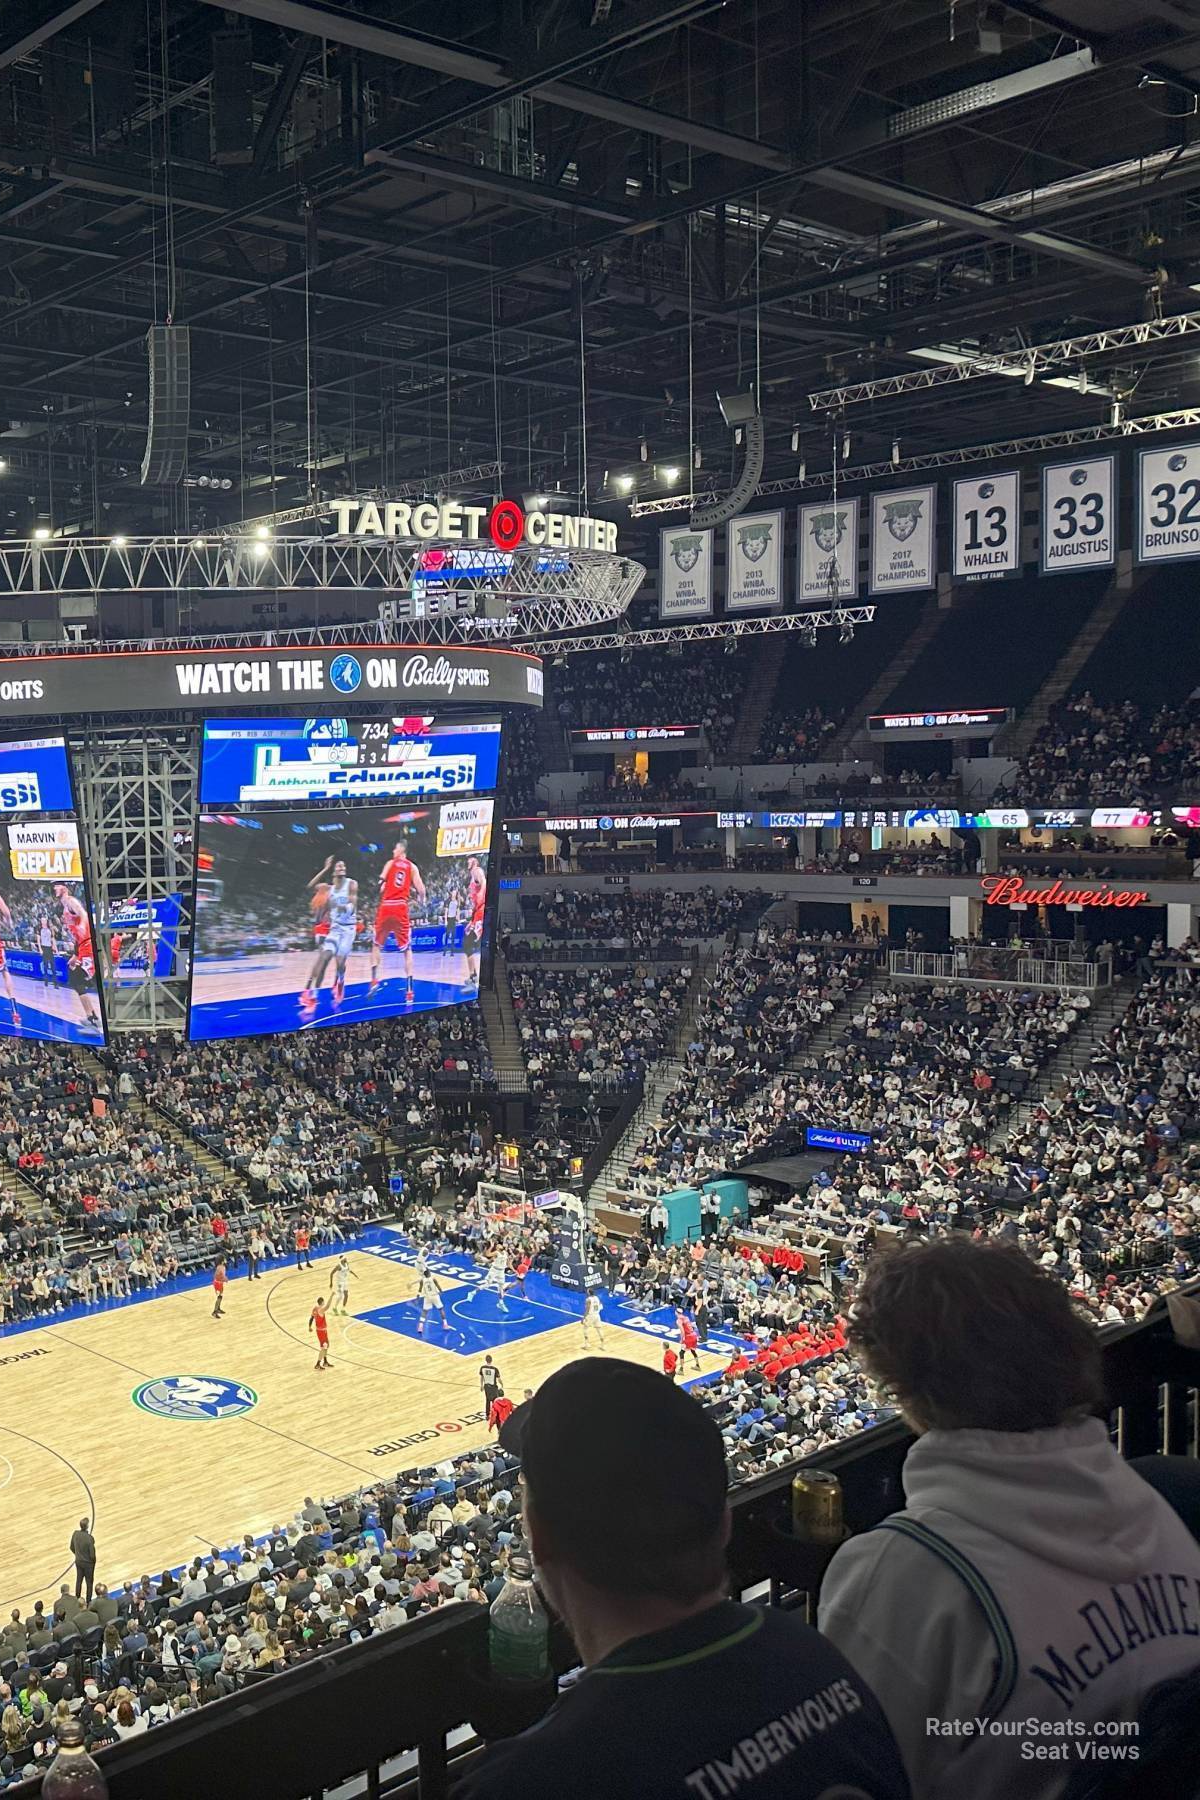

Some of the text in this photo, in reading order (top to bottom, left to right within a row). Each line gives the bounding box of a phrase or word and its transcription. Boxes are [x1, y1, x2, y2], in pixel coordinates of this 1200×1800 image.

[1150, 478, 1200, 528] 32
[1053, 492, 1104, 540] 33
[329, 499, 618, 553] TARGET CENTER
[964, 505, 1007, 551] 13
[892, 550, 912, 560] 2017
[1048, 538, 1109, 559] AUGUSTUS
[889, 559, 914, 570] WNBA
[963, 551, 1009, 568] WHALEN
[745, 570, 763, 579] 2013
[877, 568, 927, 582] CHAMPIONS
[678, 580, 694, 589] 2011
[743, 579, 765, 588] WNBA
[675, 589, 697, 598] WNBA
[732, 587, 776, 599] CHAMPIONS
[666, 597, 707, 608] CHAMPIONS
[175, 654, 490, 695] WATCH THE ON Bally SPORTS
[362, 723, 389, 740] 7:34
[587, 731, 611, 741] WATCH
[612, 731, 625, 740] THE
[637, 730, 647, 739] ON
[369, 751, 377, 764] 3
[446, 810, 478, 823] MARVIN
[545, 820, 578, 831] WATCH
[579, 820, 598, 830] THE
[614, 818, 628, 828] ON
[630, 816, 659, 829] Bally
[1002, 814, 1018, 825] 65
[1043, 811, 1075, 824] 7:34
[1104, 813, 1120, 824] 77
[16, 832, 55, 844] MARVIN
[442, 825, 488, 849] REPLAY
[17, 850, 74, 874] REPLAY
[980, 876, 1151, 907] Budweiser
[366, 1429, 441, 1457] CENTER
[1029, 1573, 1200, 1712] McDANIE
[684, 1677, 863, 1800] TIMBERWOLVES
